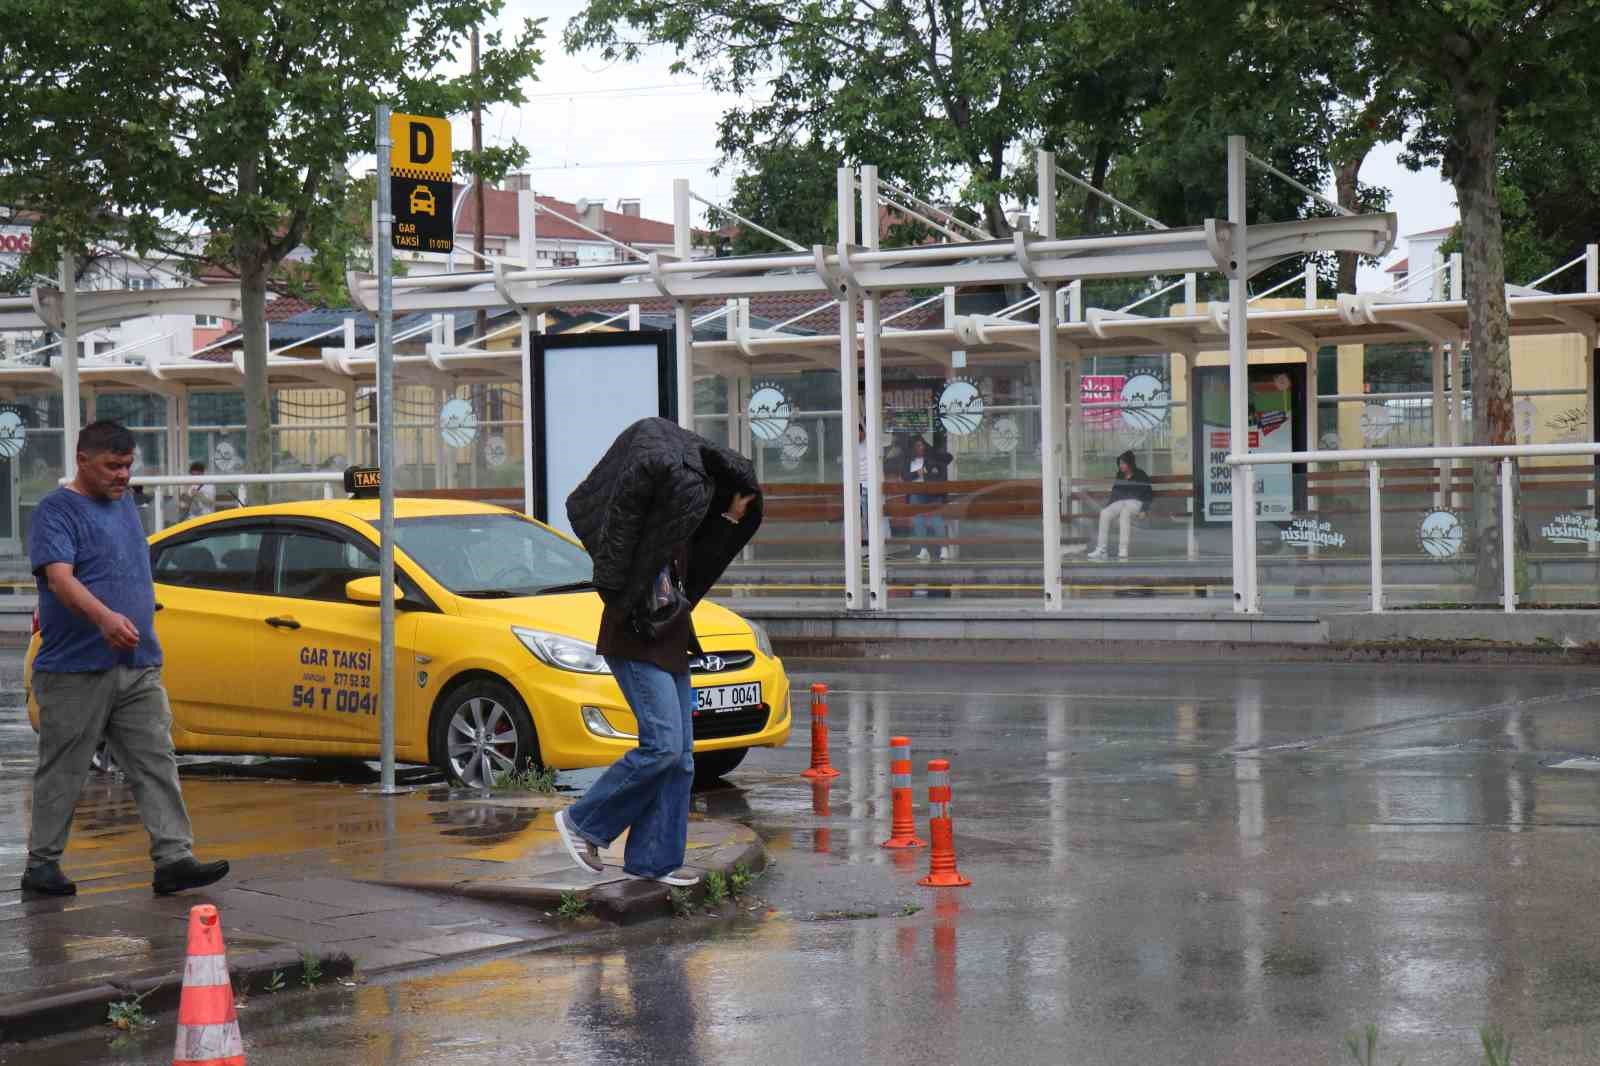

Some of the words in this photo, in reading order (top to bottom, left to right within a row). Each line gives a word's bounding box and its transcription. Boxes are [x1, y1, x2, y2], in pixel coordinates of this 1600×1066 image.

[409, 121, 434, 164] D
[398, 223, 416, 233] GAR
[395, 234, 419, 247] TAKSİ
[356, 472, 383, 484] TAKS
[1210, 465, 1232, 480] SPO
[300, 646, 328, 666] GAR
[332, 648, 372, 671] TAKSİ
[292, 684, 315, 709] 54
[321, 687, 331, 710] T
[335, 689, 379, 716] 0041
[698, 690, 713, 708] 54
[718, 688, 726, 706] T
[732, 685, 757, 704] 0041
